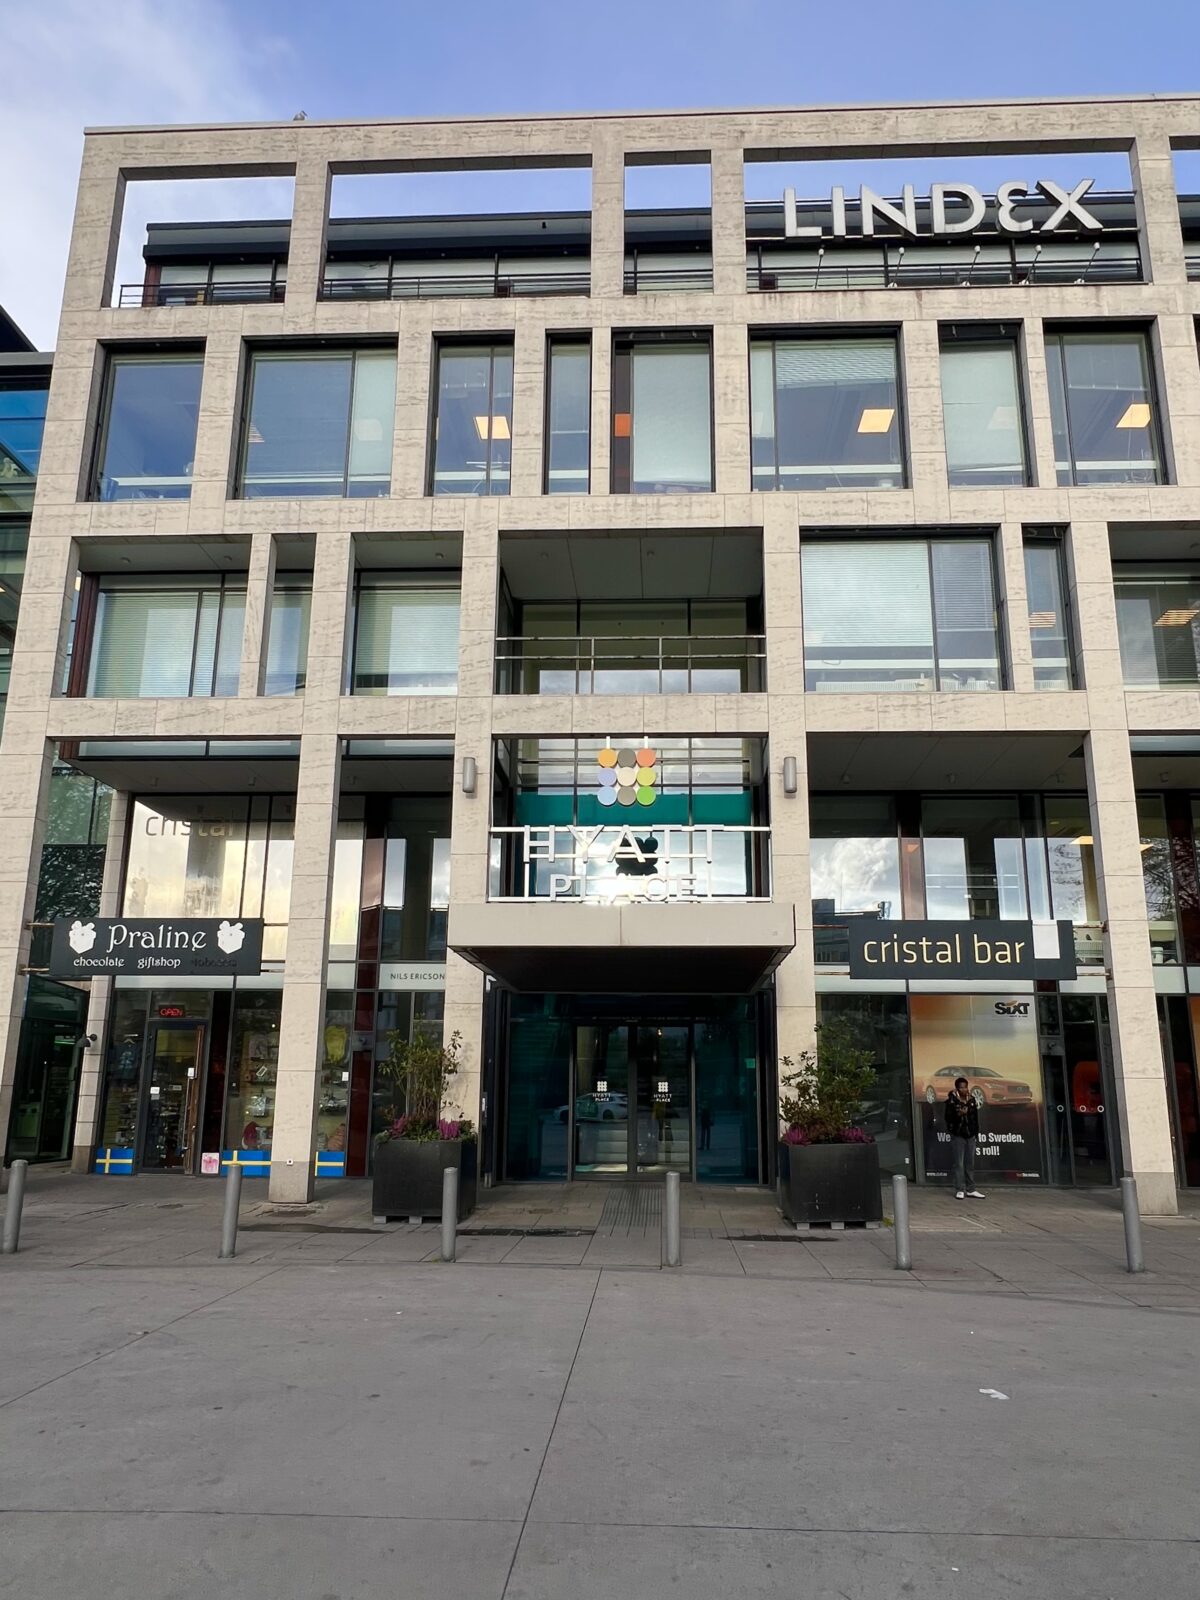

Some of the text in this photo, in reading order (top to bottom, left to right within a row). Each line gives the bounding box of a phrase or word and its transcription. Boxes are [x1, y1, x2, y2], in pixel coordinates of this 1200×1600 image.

[784, 178, 1103, 242] LINDEX
[523, 824, 725, 864] HYATT
[106, 924, 207, 953] Praline
[863, 933, 1025, 964] cristal bar
[73, 956, 125, 968] chocolate
[137, 956, 181, 969] giftshop
[390, 972, 445, 980] NILS ERICSON
[978, 1132, 1025, 1144] to Sweden,
[982, 1146, 1000, 1156] roll!
